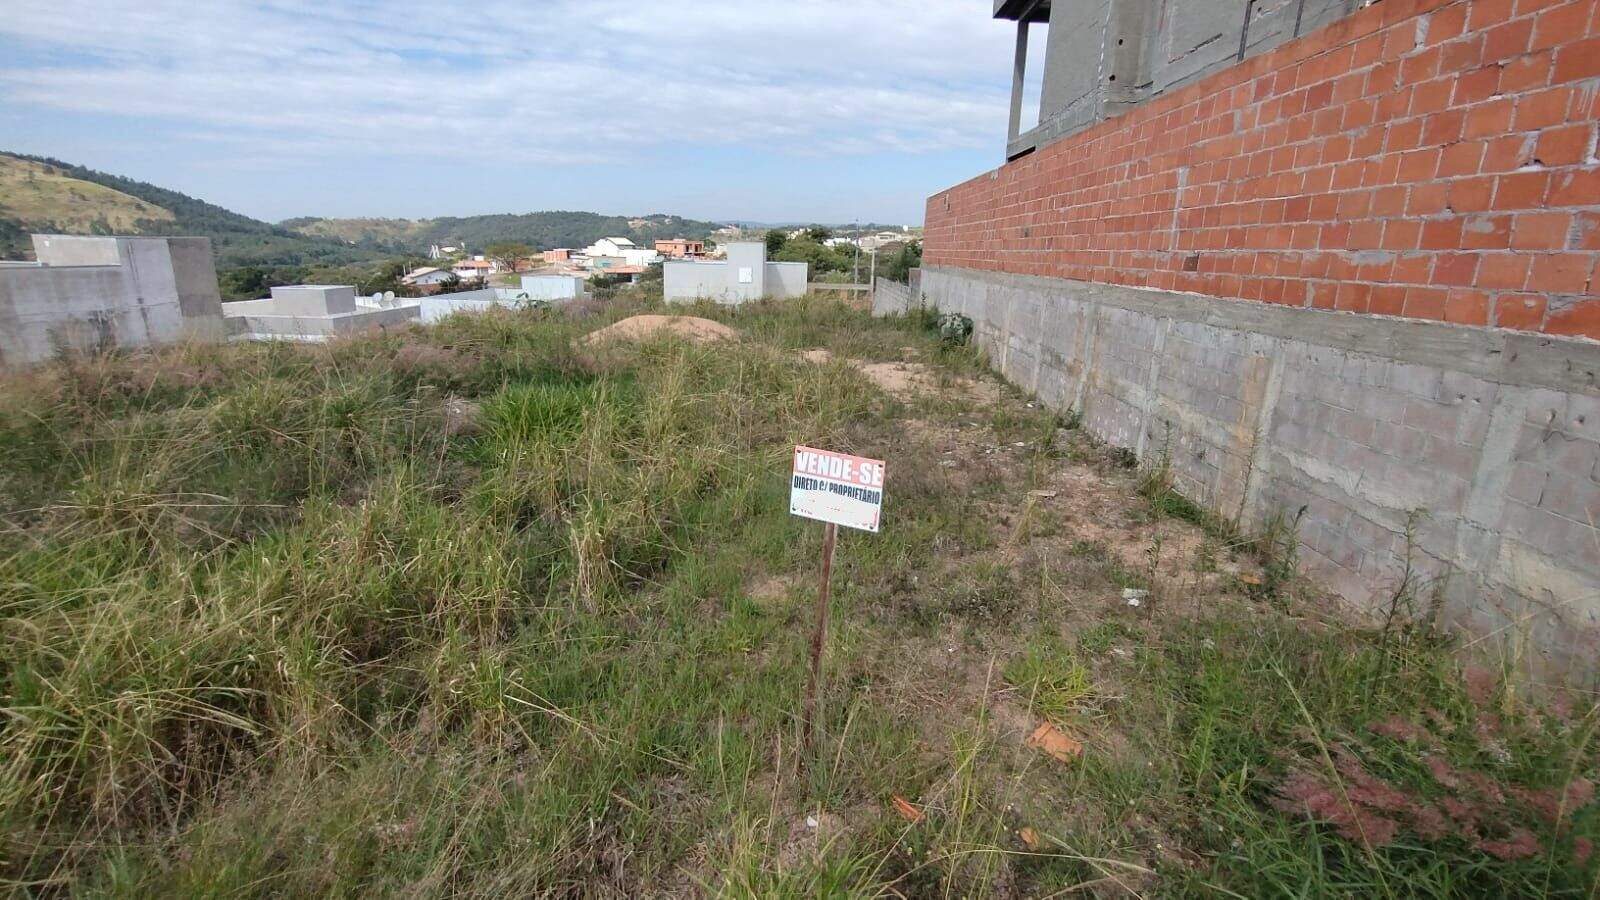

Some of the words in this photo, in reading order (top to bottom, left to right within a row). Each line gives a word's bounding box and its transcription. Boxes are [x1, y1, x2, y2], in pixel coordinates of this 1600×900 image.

[796, 451, 881, 486] VENDE-SE
[793, 475, 818, 491] DIRETO
[829, 482, 880, 505] PROPRIETÁRIO
